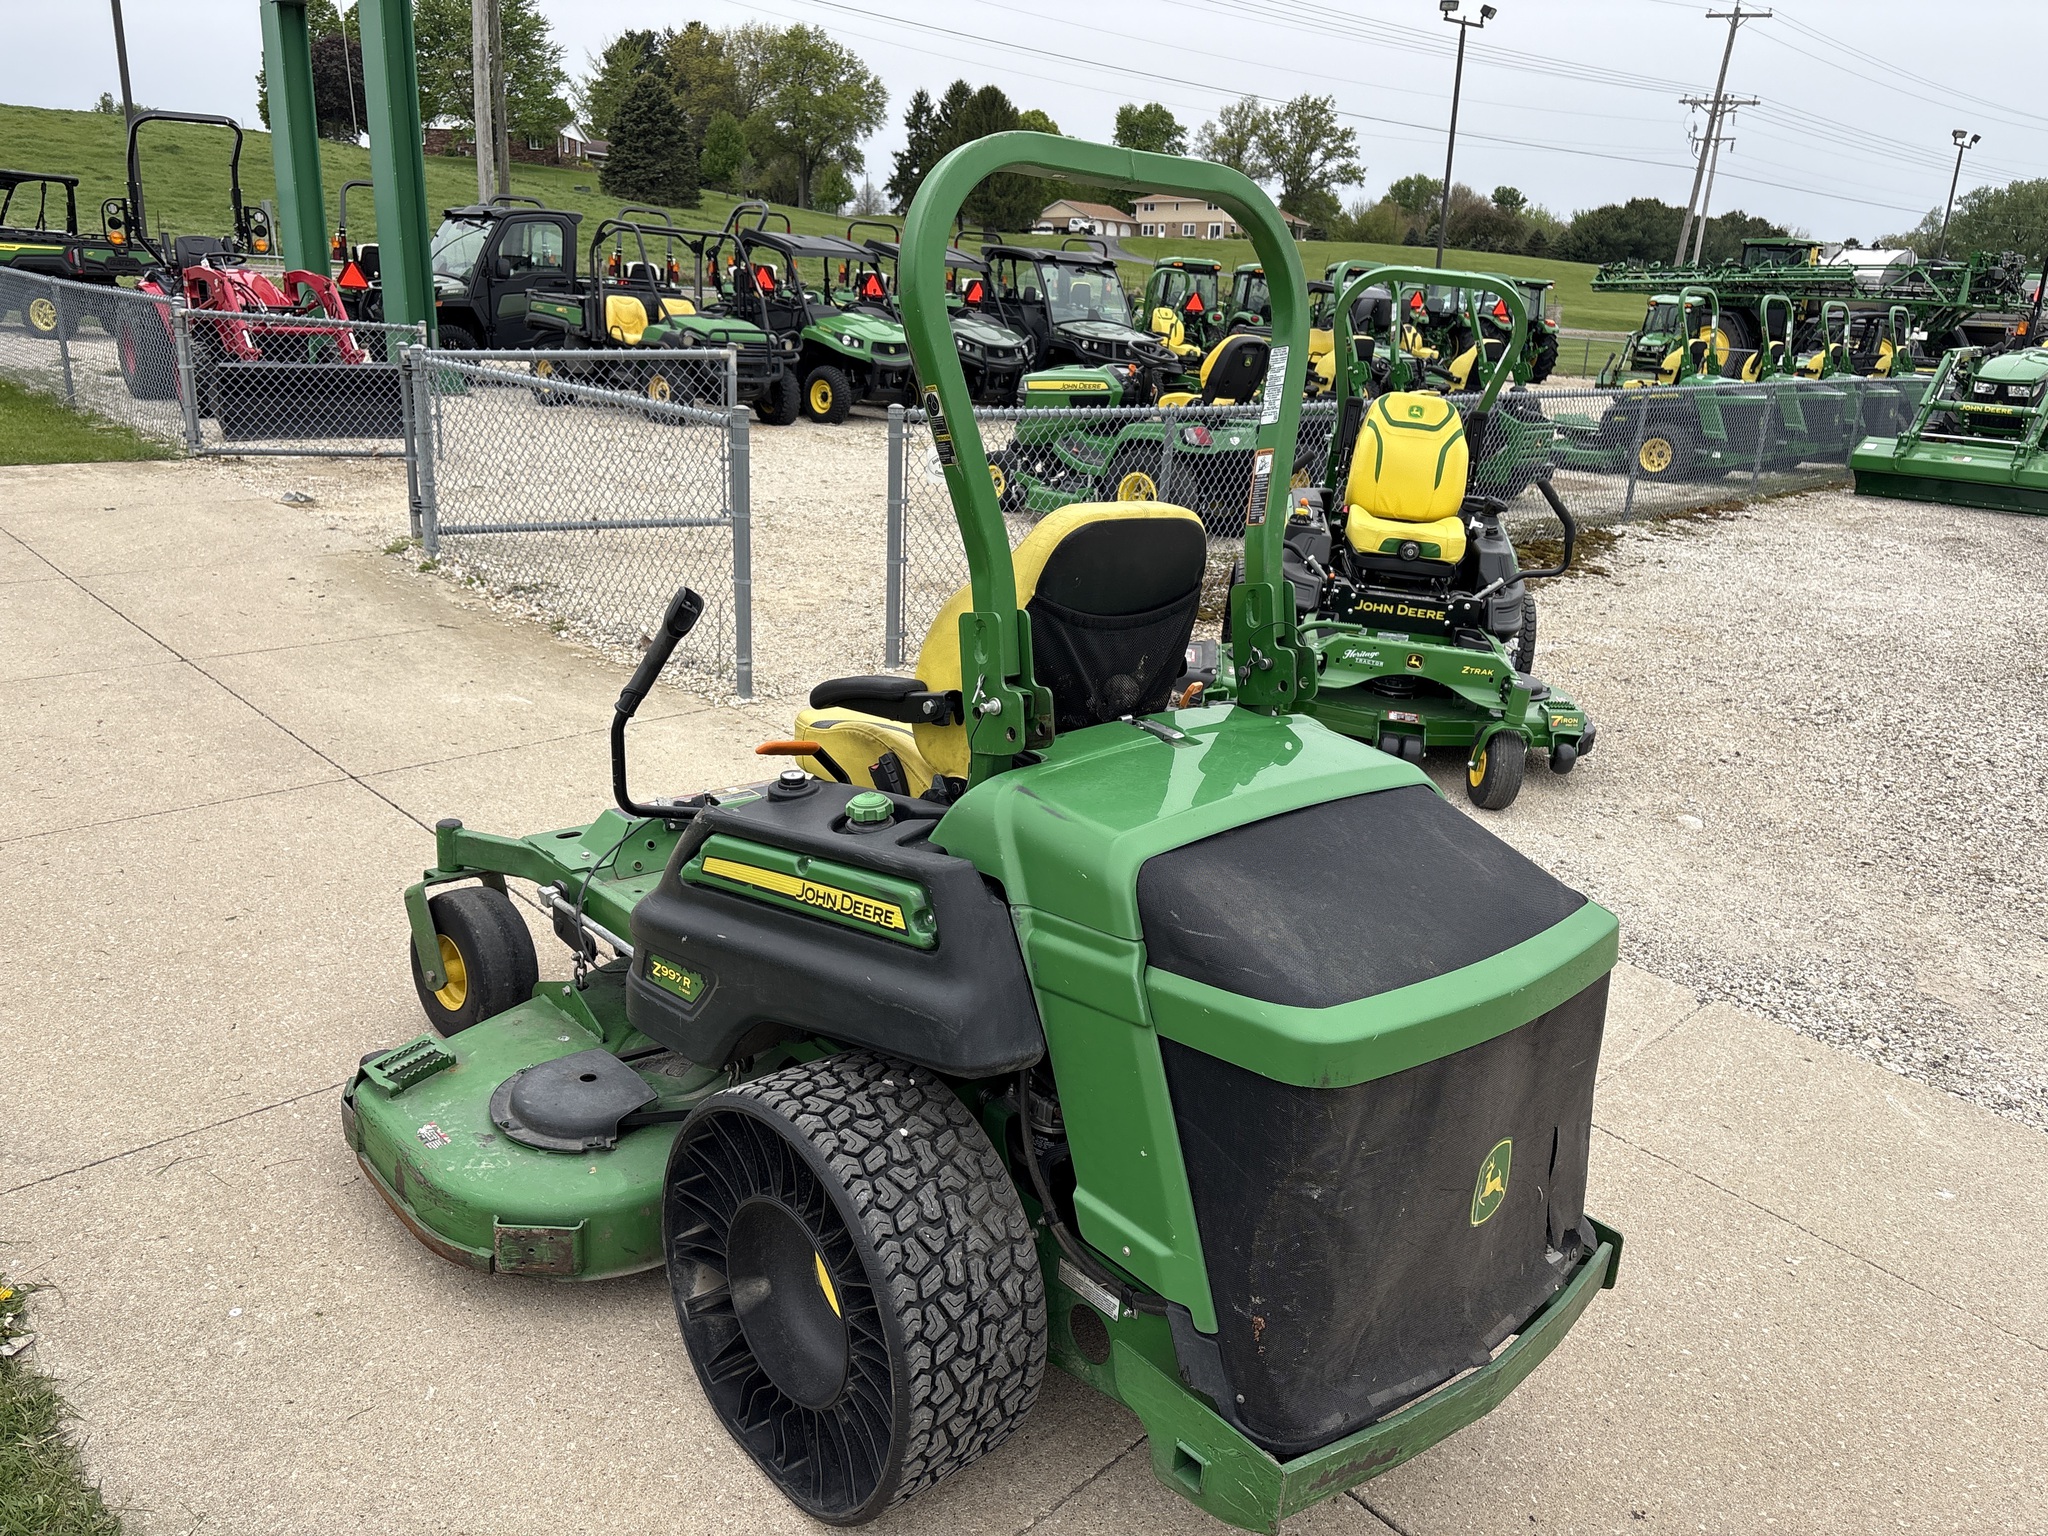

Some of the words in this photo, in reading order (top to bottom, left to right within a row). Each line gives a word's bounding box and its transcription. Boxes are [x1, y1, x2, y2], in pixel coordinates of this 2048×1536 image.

[1079, 382, 1102, 390] DEERE
[1960, 404, 1983, 412] JOHN
[1984, 405, 2013, 415] DEERE
[1354, 599, 1394, 614] JOHN
[1396, 604, 1446, 620] DEERE
[1342, 649, 1380, 659] Heritage
[795, 882, 838, 908] JOHN
[840, 893, 895, 925] DEERE
